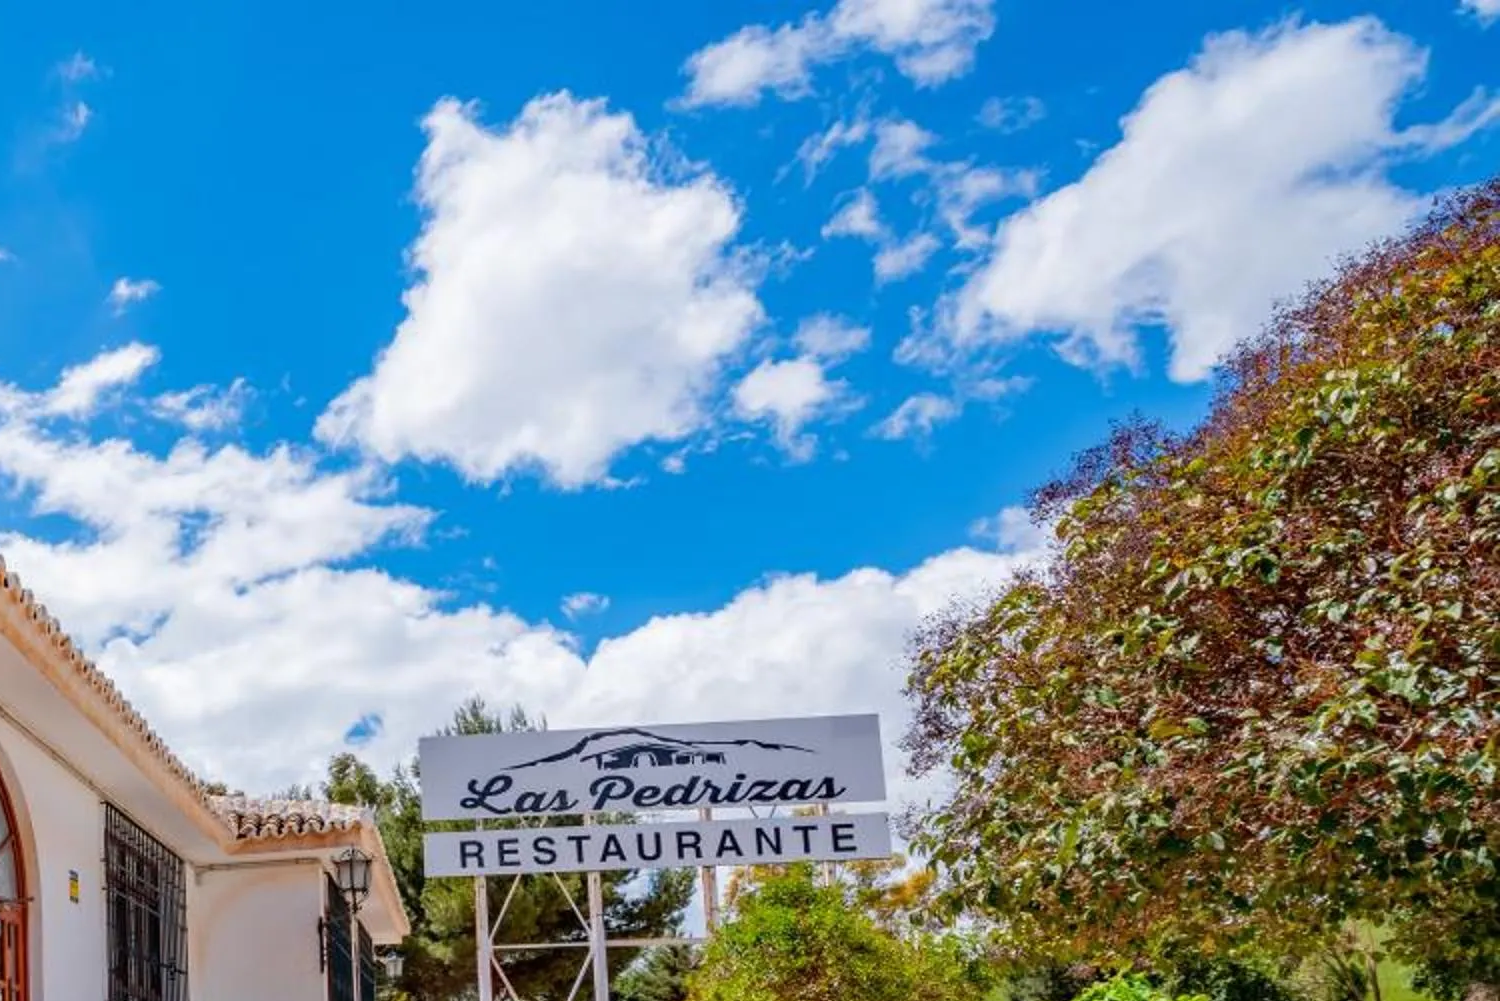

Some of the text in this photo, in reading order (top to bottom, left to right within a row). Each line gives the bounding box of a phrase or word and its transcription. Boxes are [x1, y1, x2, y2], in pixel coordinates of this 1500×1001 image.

[460, 772, 846, 815] Las Pedrizas
[459, 823, 858, 869] RESTAURANTE
